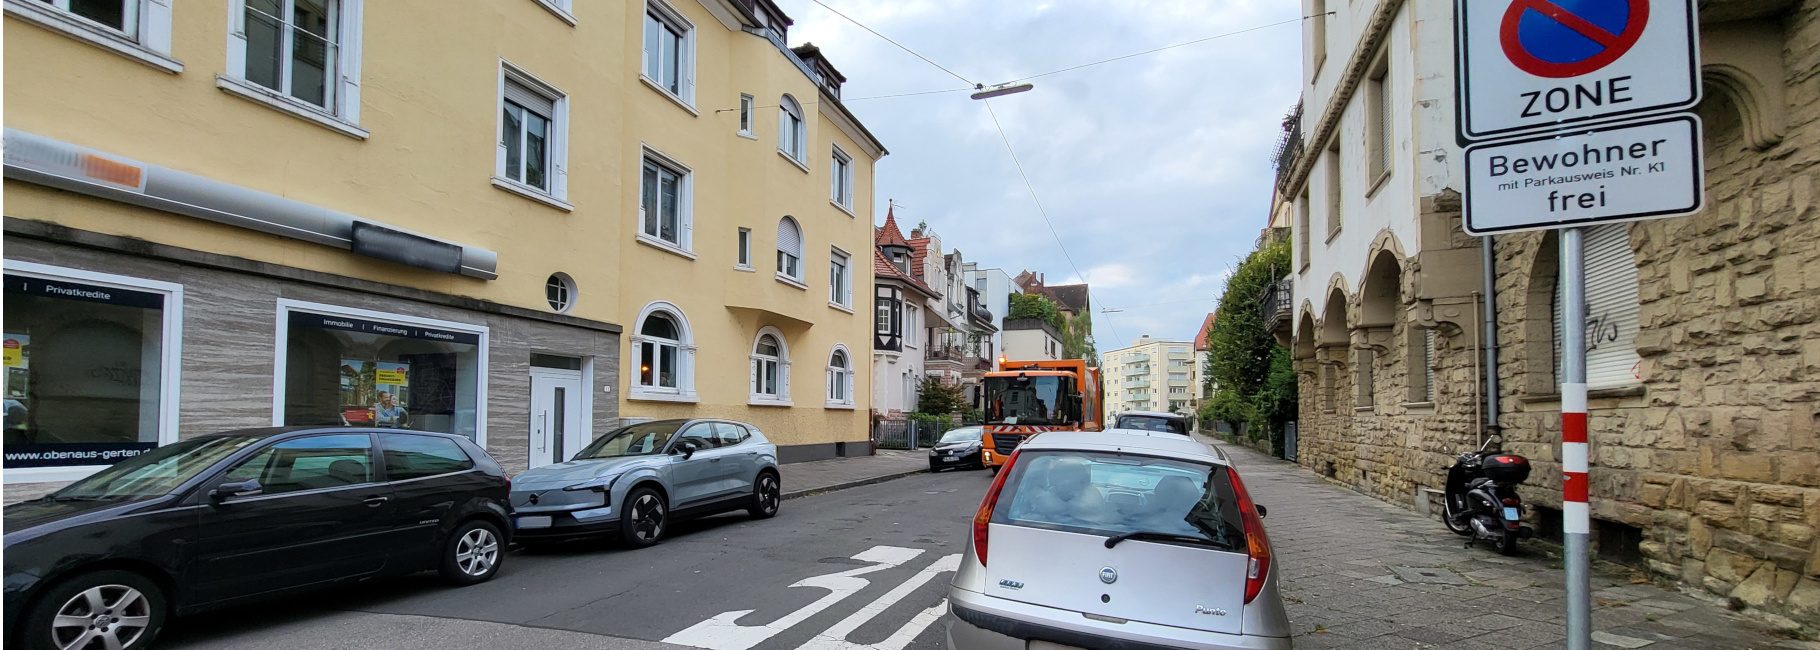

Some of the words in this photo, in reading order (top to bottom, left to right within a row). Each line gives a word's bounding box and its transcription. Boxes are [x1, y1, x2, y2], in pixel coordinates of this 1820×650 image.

[1520, 75, 1633, 118] ZONE
[1489, 139, 1667, 177] Bewohner
[1498, 180, 1519, 191] mit
[1524, 169, 1615, 188] Parkausweis
[1620, 165, 1642, 177] Nr.
[1648, 161, 1665, 174] K1
[1547, 185, 1605, 212] frei
[45, 284, 111, 300] Privatkredite
[323, 318, 354, 329] Immobilie
[372, 324, 408, 336] Finanzierung
[424, 331, 455, 340] Privatkredite
[5, 448, 151, 461] www.obenaus-gerten
[1102, 571, 1114, 579] FIAT
[1195, 604, 1227, 616] Punto
